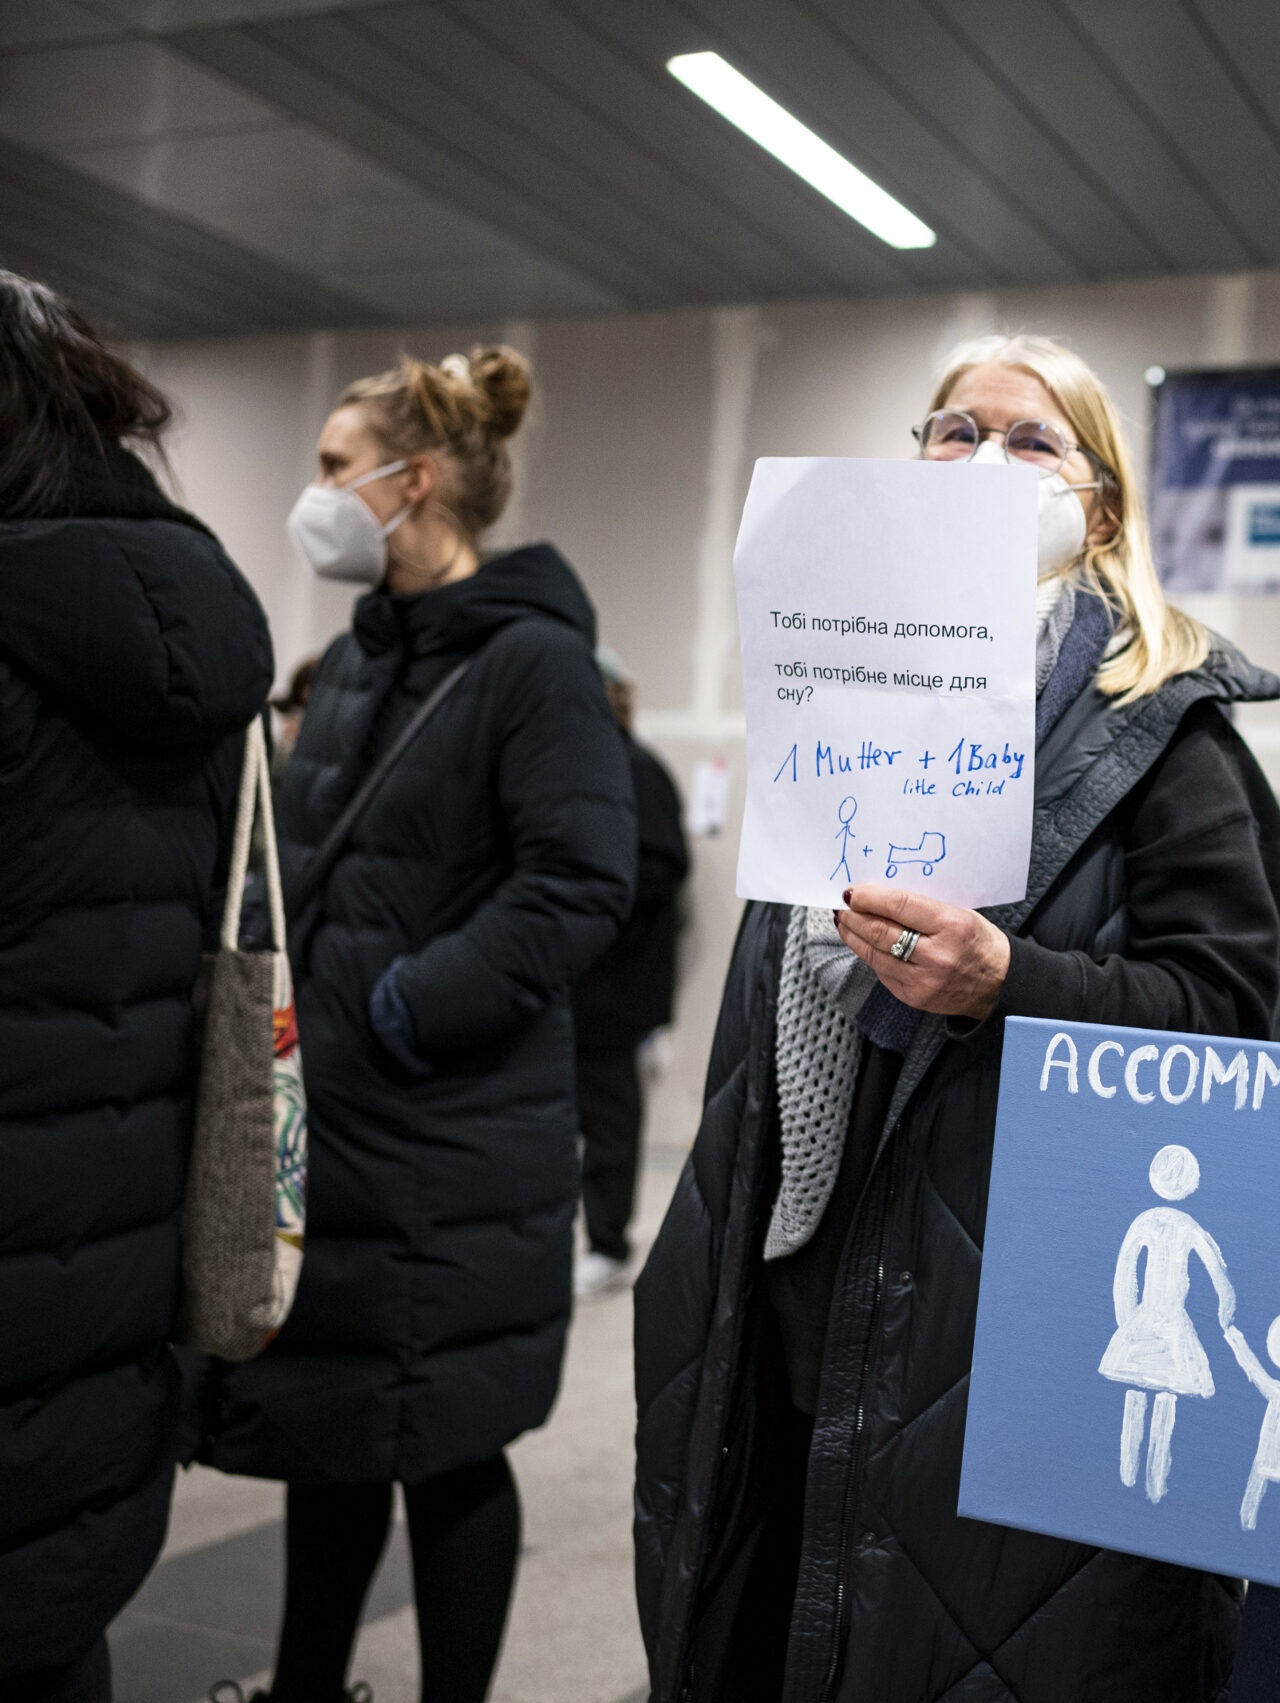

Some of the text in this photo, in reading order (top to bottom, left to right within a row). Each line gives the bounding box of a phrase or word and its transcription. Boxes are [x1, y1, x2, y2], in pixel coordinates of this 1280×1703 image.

[770, 611, 994, 642] Тобі потрібна допомога,
[775, 661, 987, 691] тобі потрібне місце для
[777, 685, 814, 705] сну?
[774, 743, 797, 782] 1
[816, 740, 902, 777] Mutter
[918, 750, 936, 769] +
